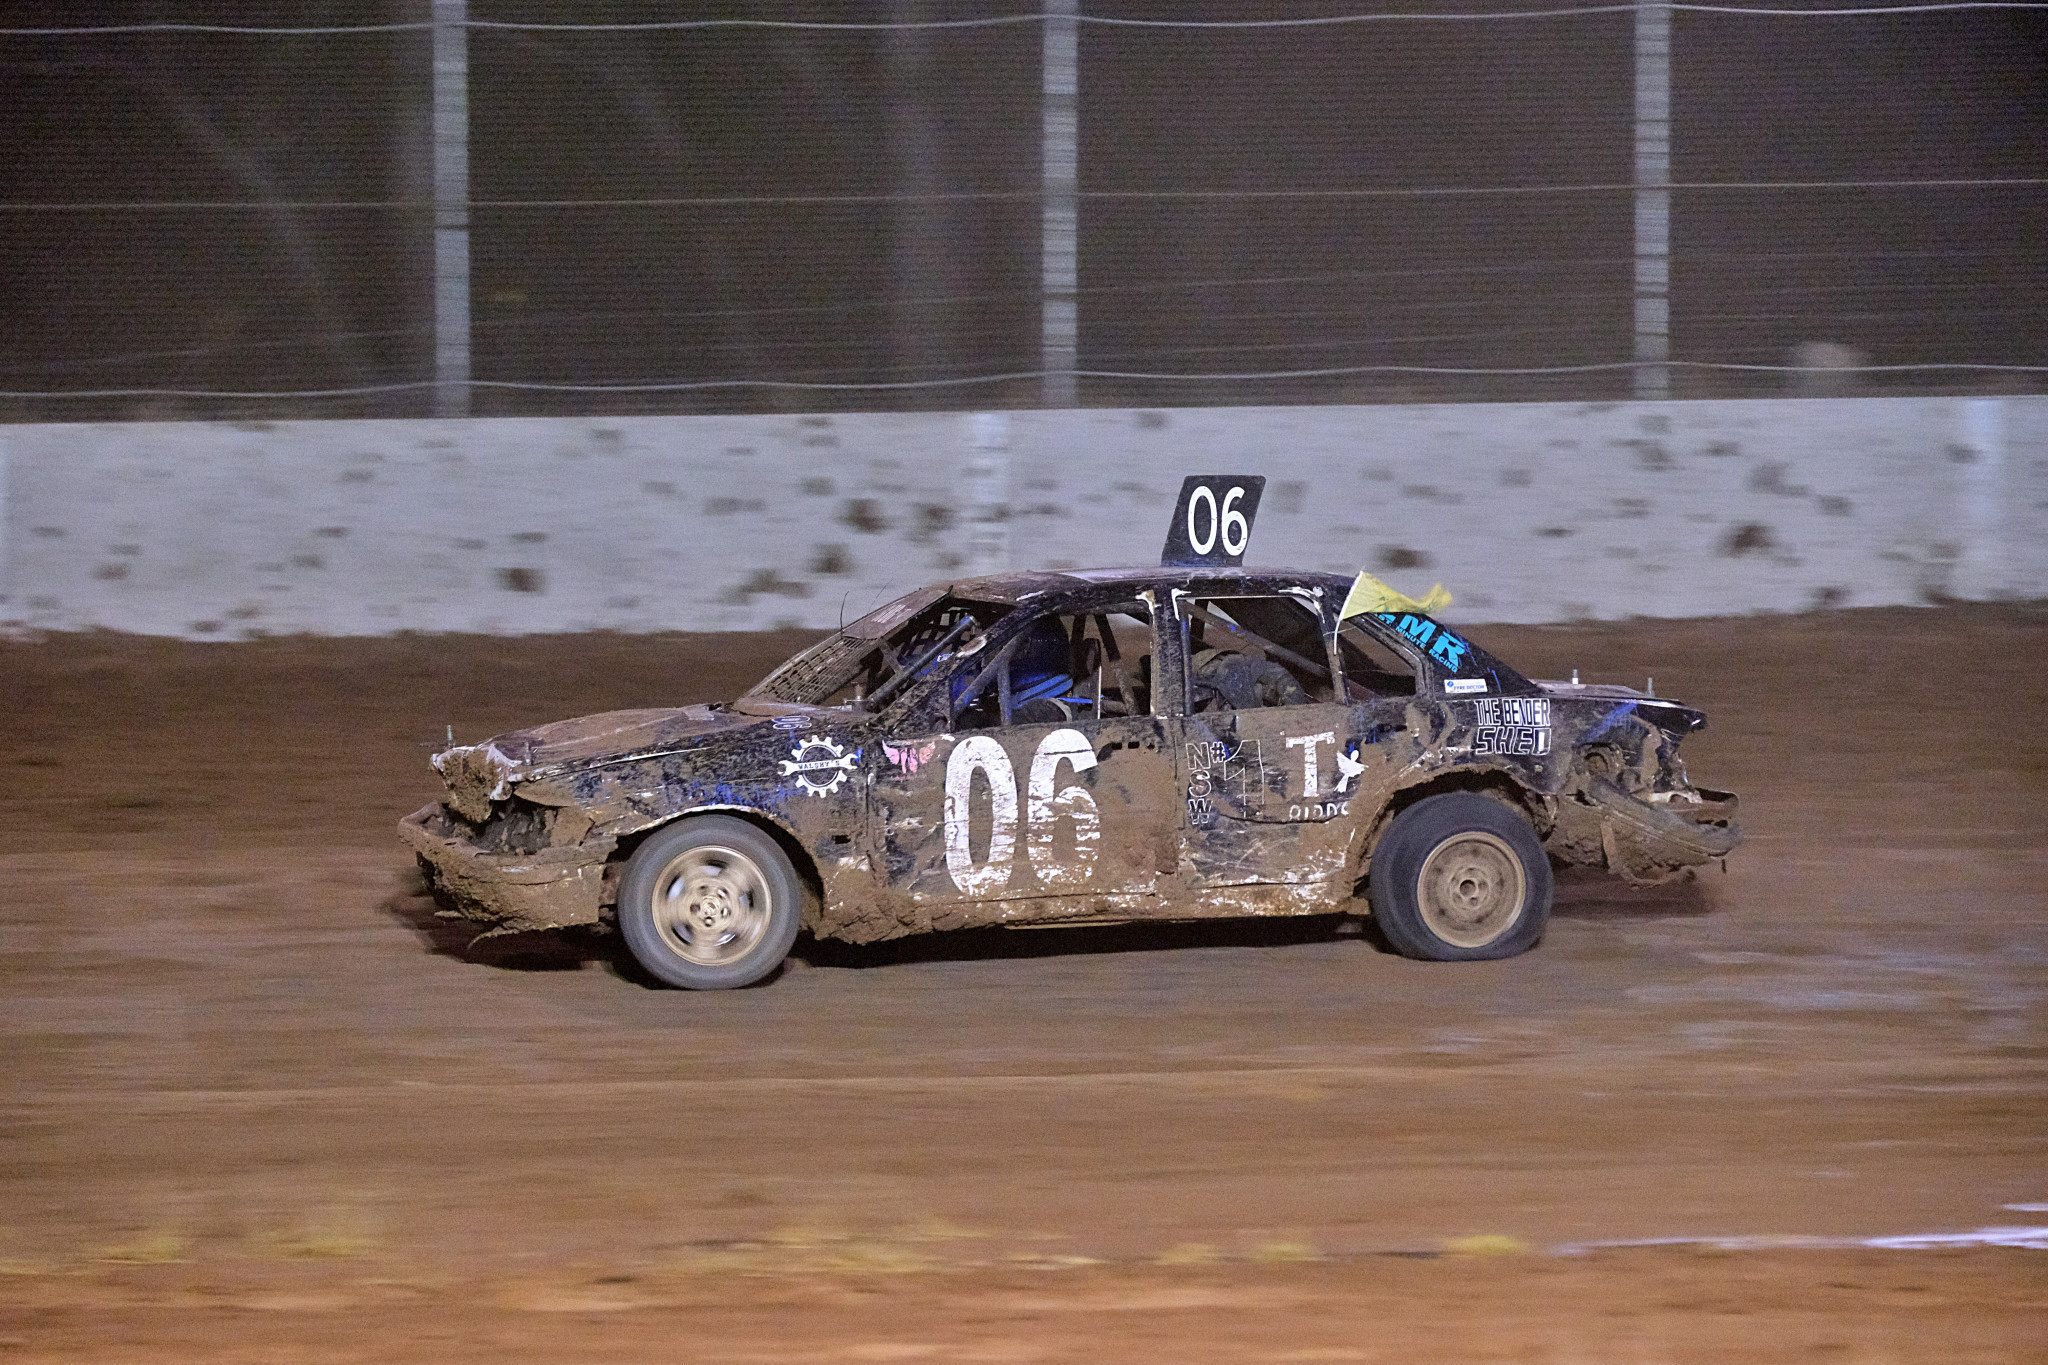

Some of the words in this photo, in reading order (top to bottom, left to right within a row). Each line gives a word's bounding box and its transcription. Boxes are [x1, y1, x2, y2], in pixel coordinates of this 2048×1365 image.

[1187, 485, 1248, 556] 06
[1379, 613, 1467, 668] MR
[1395, 625, 1427, 650] MINUTE
[1428, 648, 1459, 674] RACING
[1473, 697, 1501, 727] THE
[1501, 697, 1552, 728] BENDER
[1475, 726, 1553, 757] SHED
[943, 728, 1101, 897] 06
